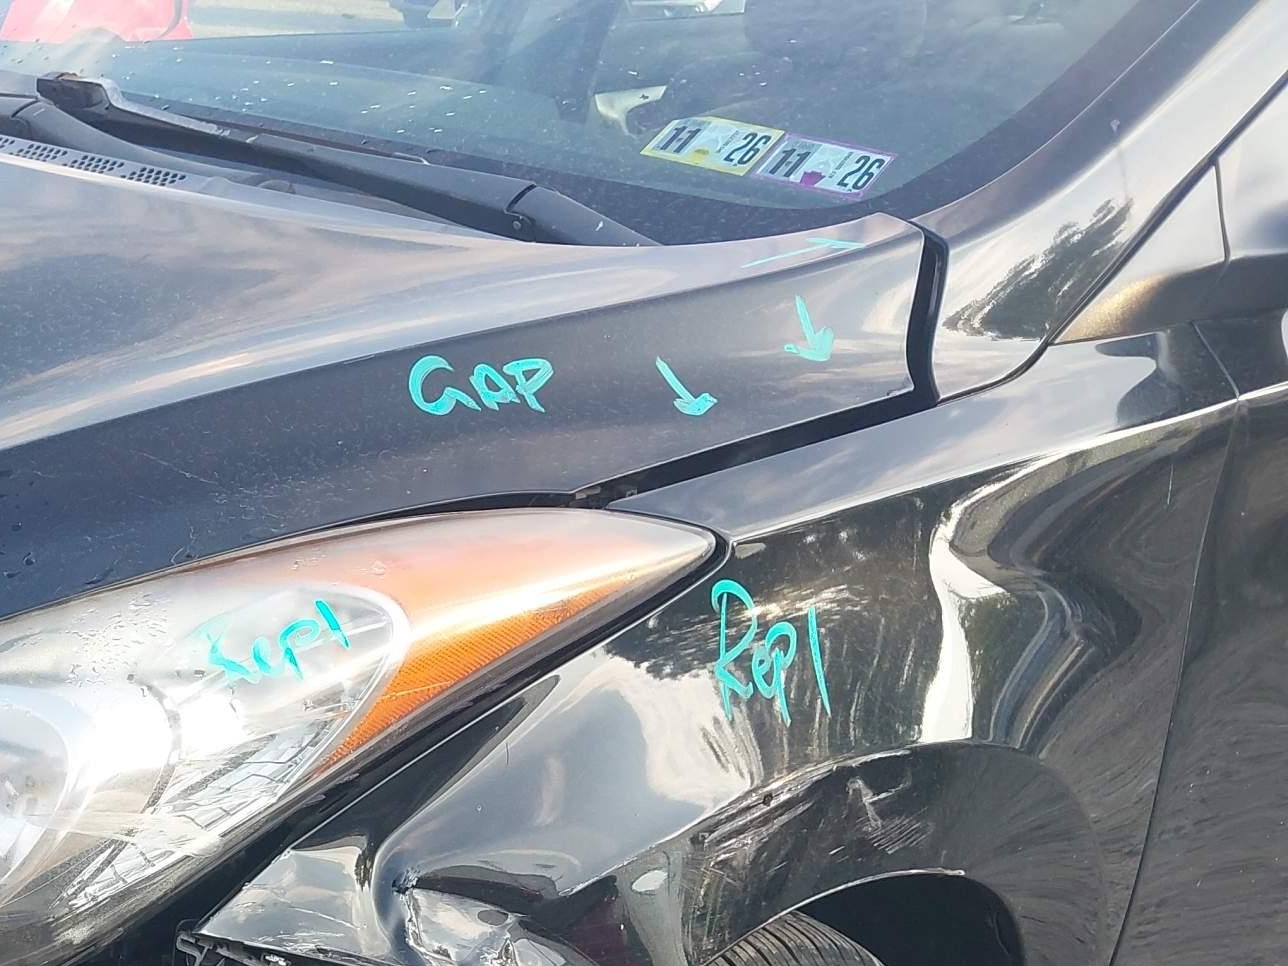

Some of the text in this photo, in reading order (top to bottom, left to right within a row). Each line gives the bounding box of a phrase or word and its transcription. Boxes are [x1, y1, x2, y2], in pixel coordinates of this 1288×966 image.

[659, 125, 702, 154] 11
[723, 132, 772, 166] 26
[768, 148, 812, 178] 11
[836, 154, 886, 191] 26
[408, 354, 554, 416] GAP
